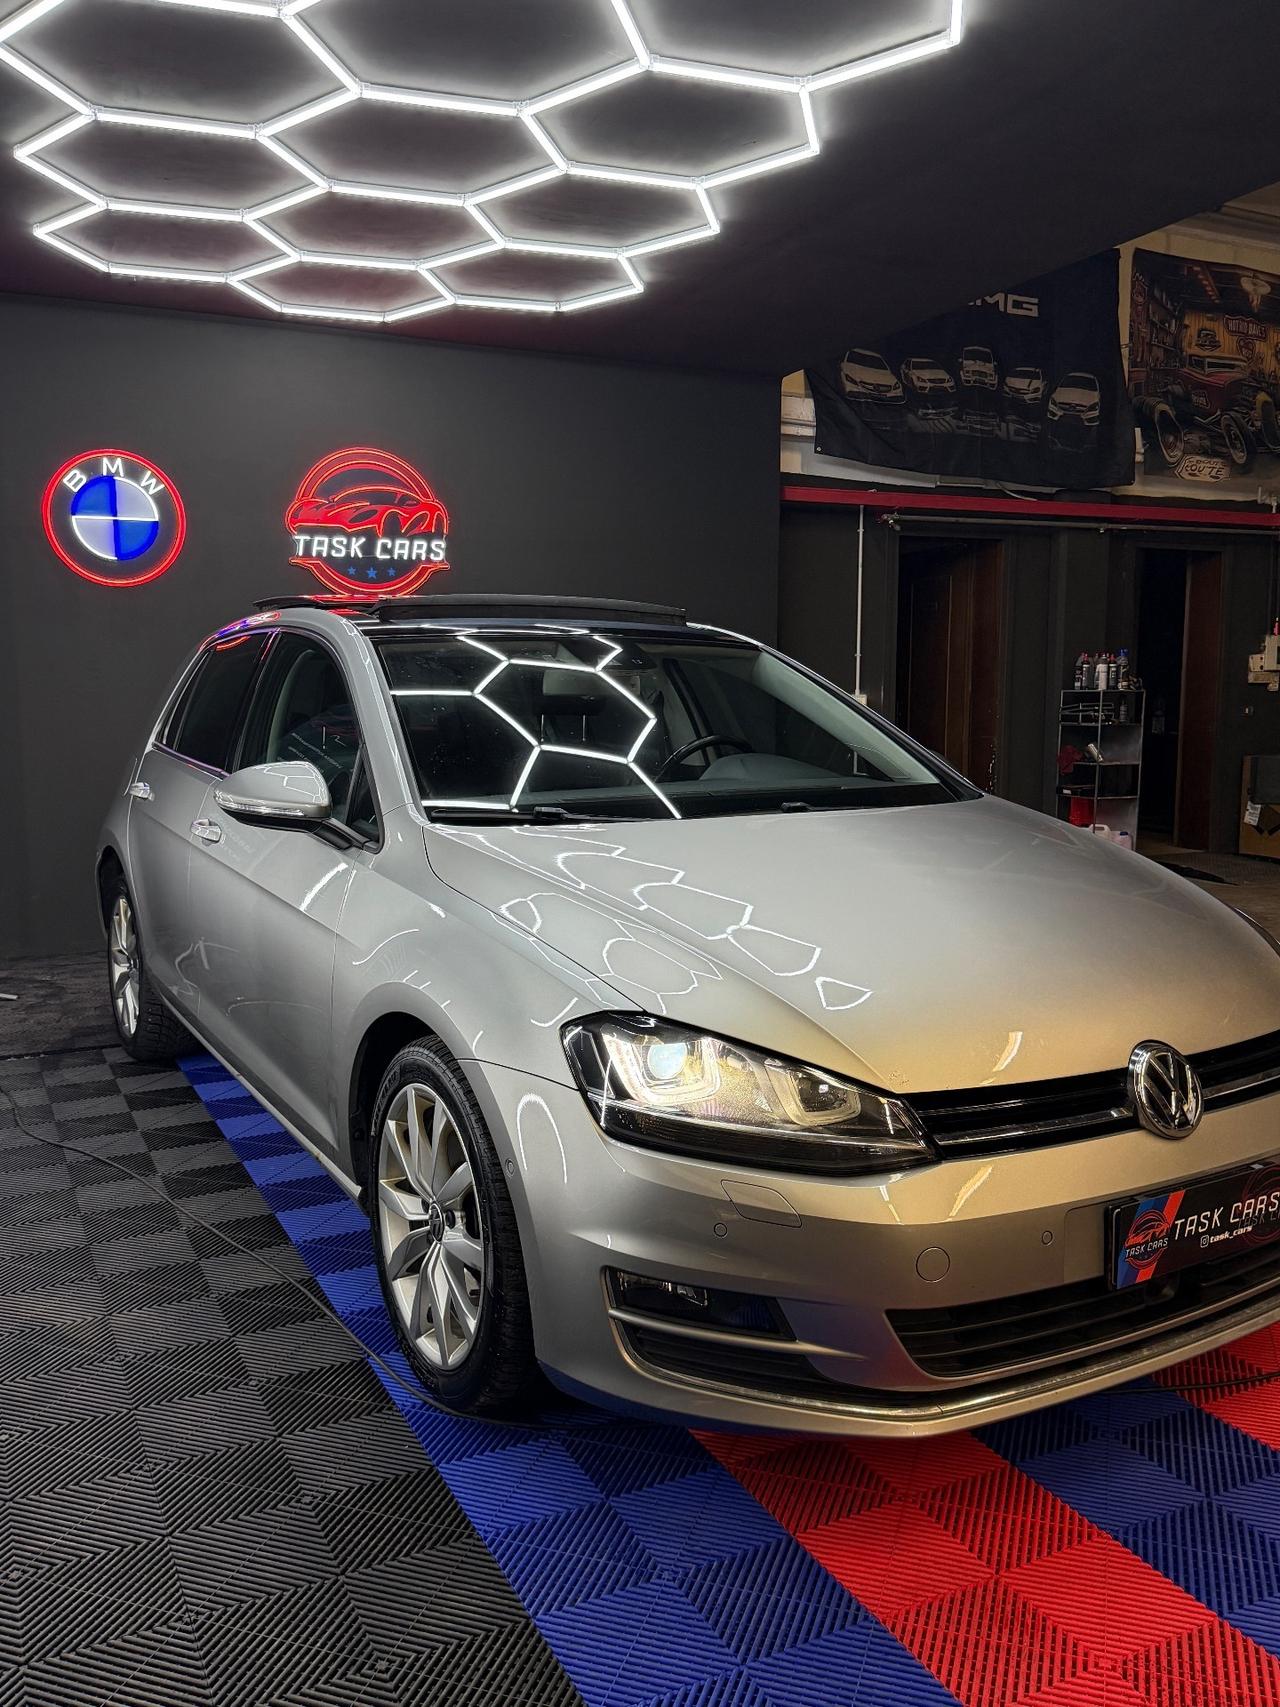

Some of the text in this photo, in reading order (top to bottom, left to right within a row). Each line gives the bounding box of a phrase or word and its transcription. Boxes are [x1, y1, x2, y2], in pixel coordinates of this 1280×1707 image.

[62, 457, 164, 494] BMW
[294, 535, 446, 561] TASK CARS
[1174, 1206, 1224, 1240] TASK
[1229, 1191, 1280, 1224] CARS
[1209, 1225, 1253, 1243] task_cars
[1125, 1237, 1169, 1258] TASK CARS
